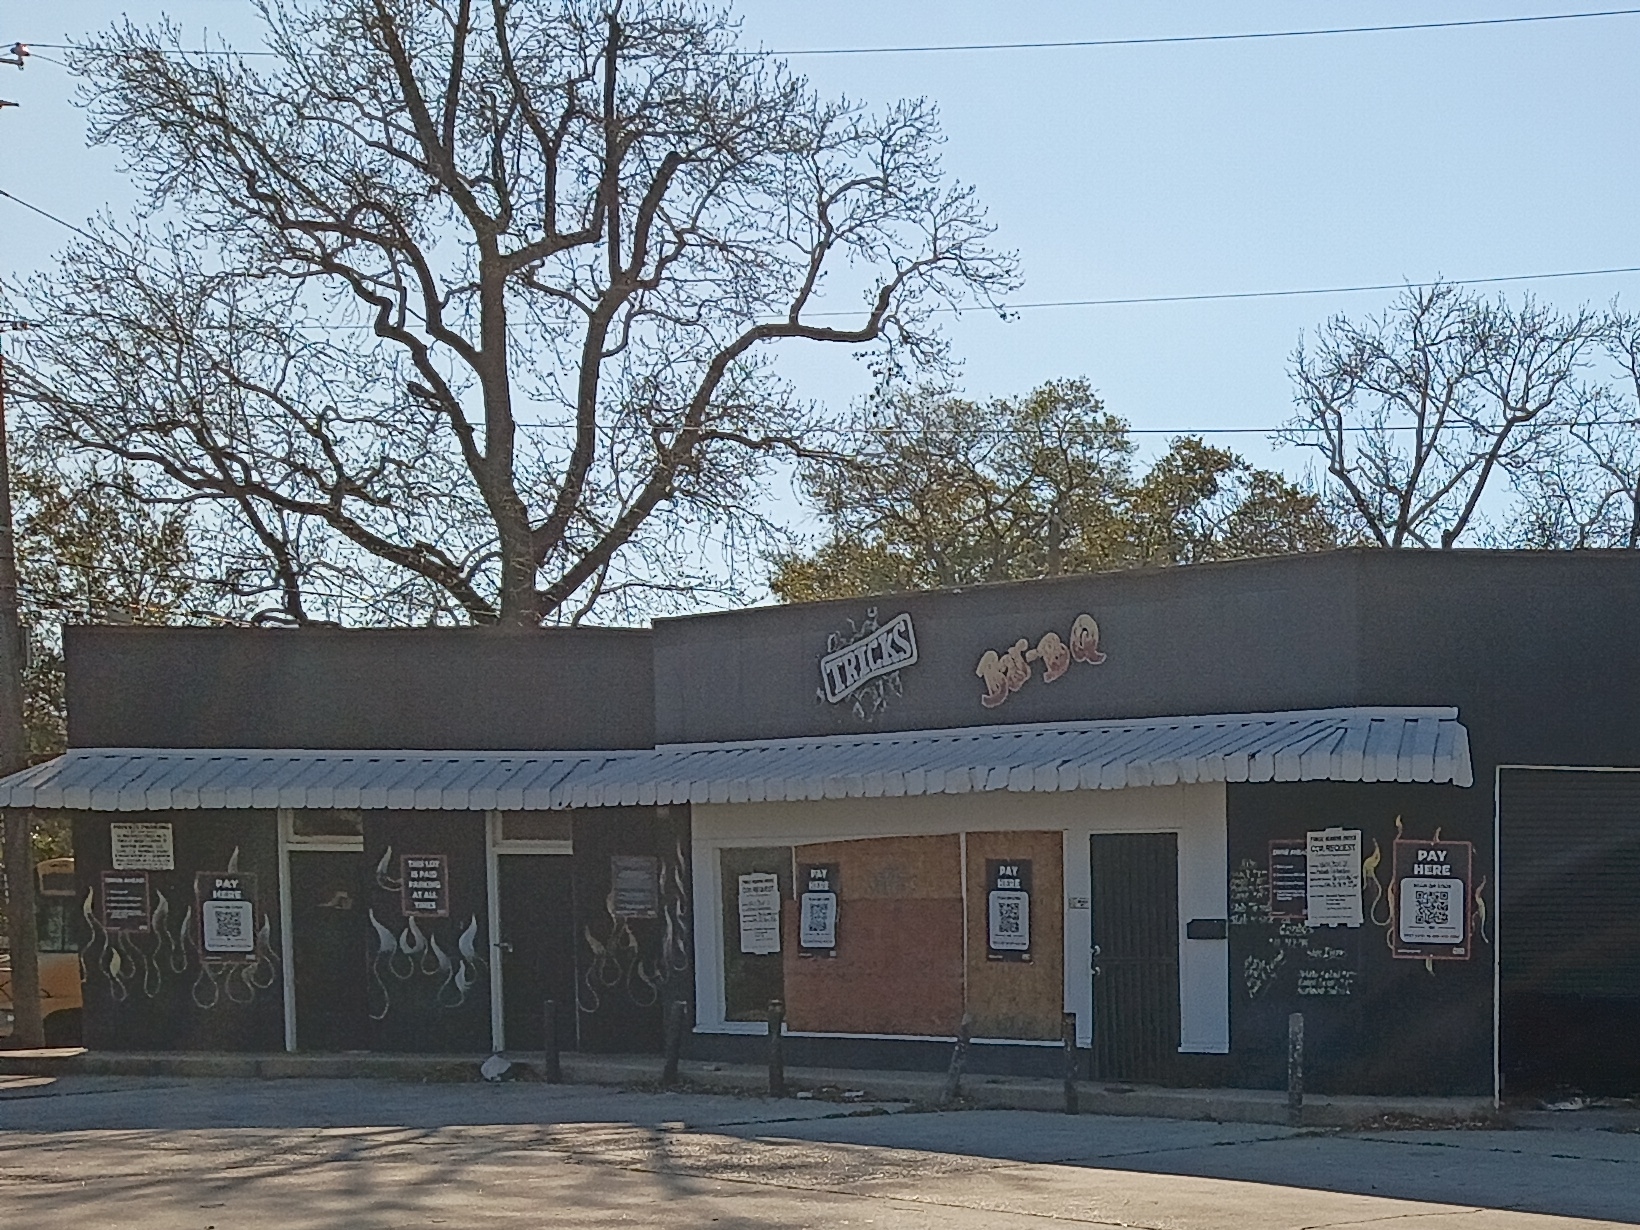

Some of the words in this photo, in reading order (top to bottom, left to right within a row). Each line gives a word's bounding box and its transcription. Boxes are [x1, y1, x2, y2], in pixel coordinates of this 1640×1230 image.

[824, 620, 912, 694] TRICKS
[1417, 849, 1447, 862] PAY
[999, 865, 1019, 877] PAY
[1413, 863, 1451, 876] HERE
[215, 878, 239, 889] PAY
